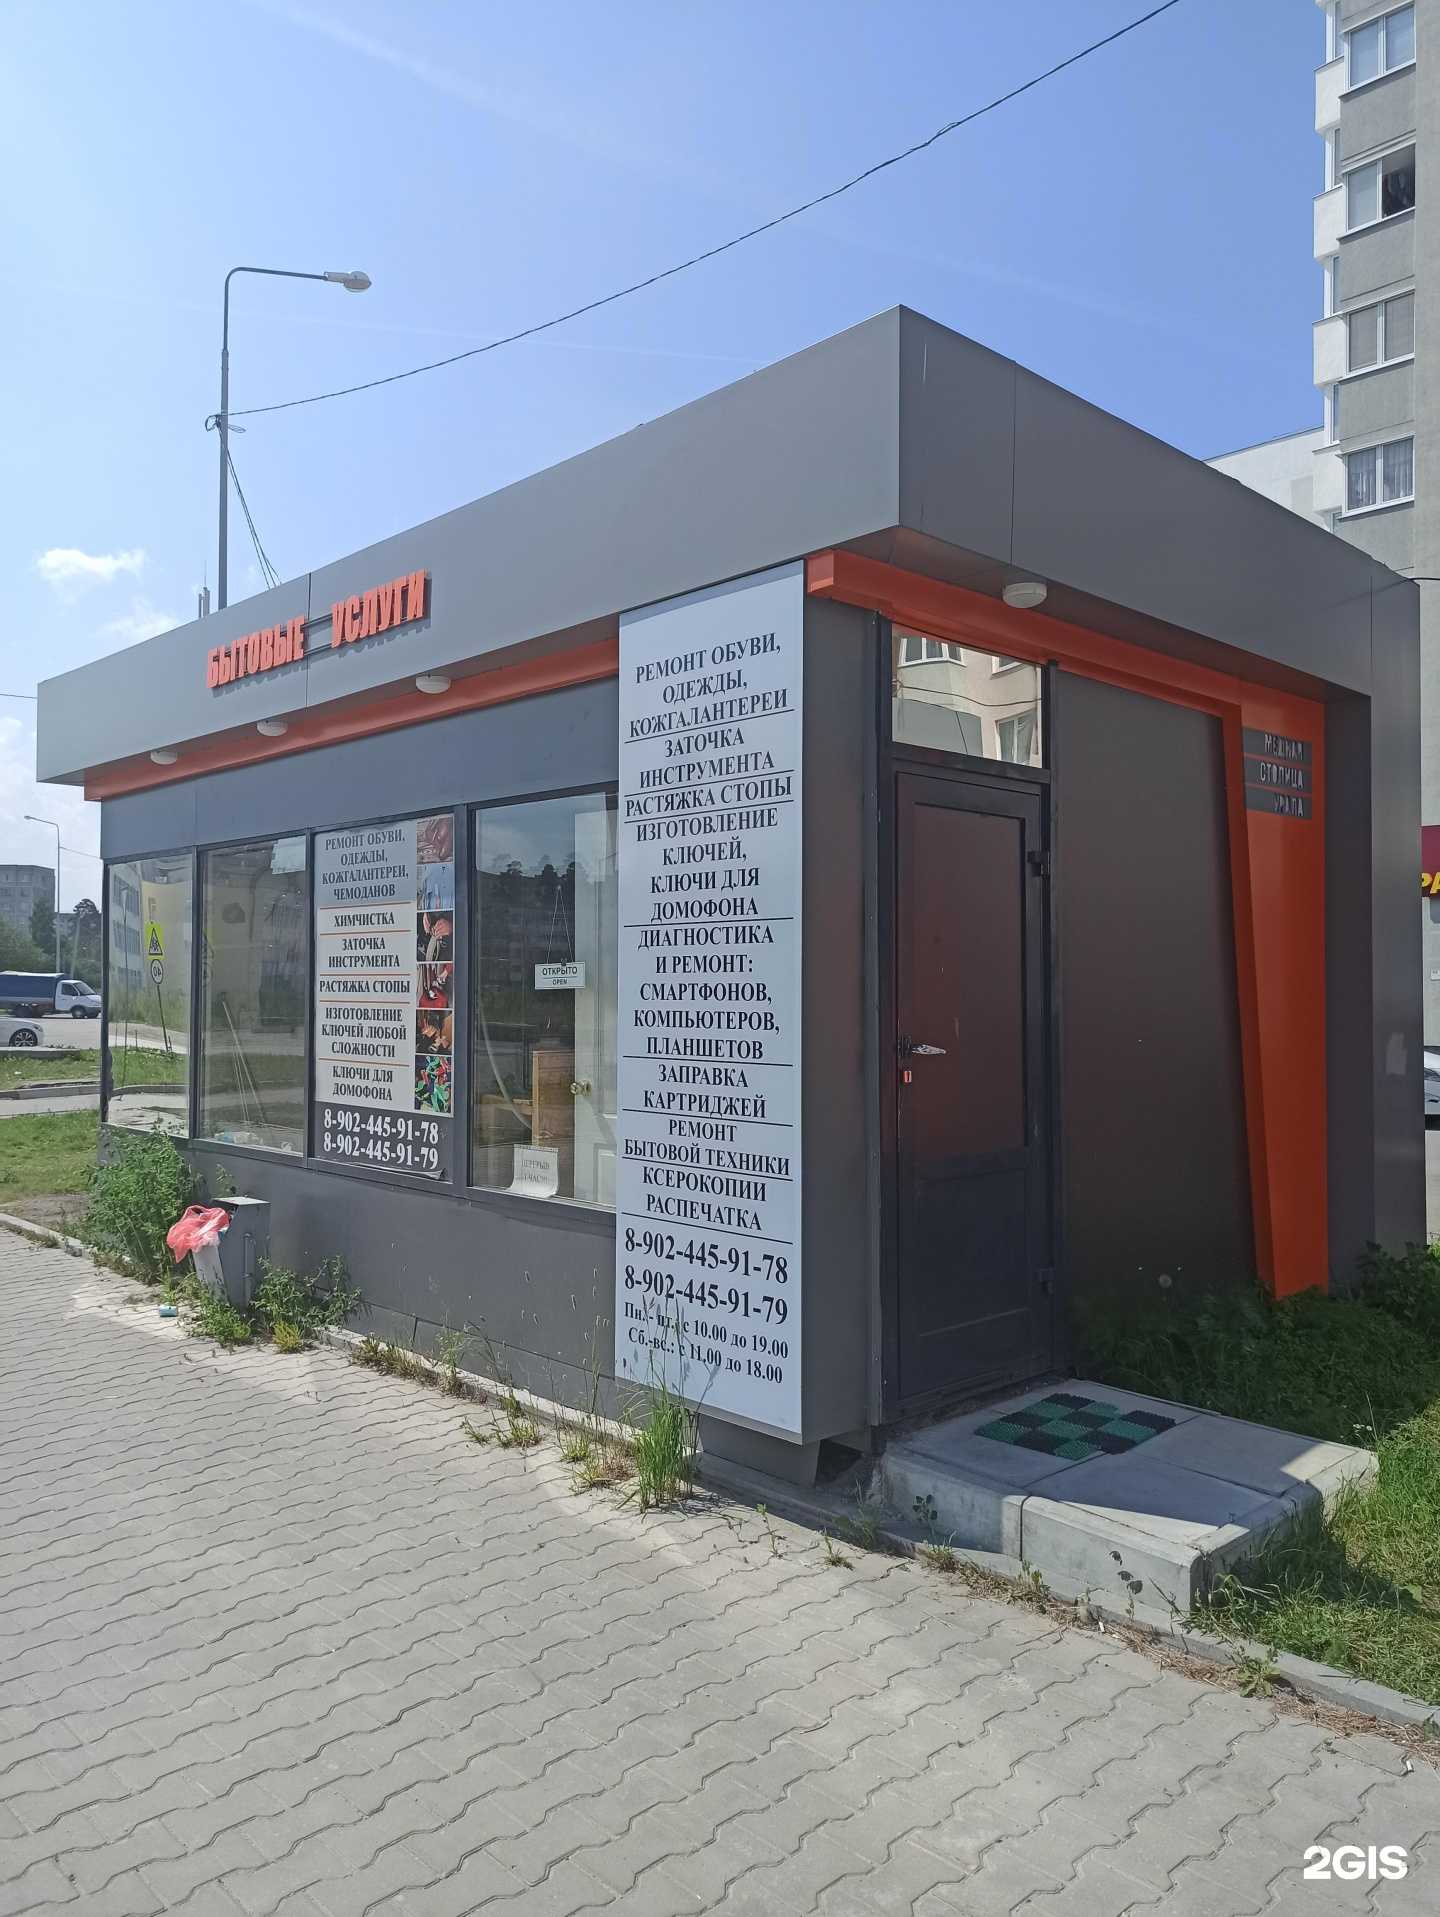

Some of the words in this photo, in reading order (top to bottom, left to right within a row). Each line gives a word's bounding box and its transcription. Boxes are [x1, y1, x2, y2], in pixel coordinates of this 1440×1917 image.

[206, 615, 305, 689] БЫТОВЫЕ
[331, 569, 427, 649] УСЛУГИ
[636, 650, 707, 684] РЕМОНТ
[711, 632, 781, 665] ОБУВИ,
[663, 669, 747, 705] ОДЕЖДЫ,
[630, 689, 787, 738] КОЖГАЛАНТЕРЕИ
[664, 727, 744, 758] ЗАТОЧКА
[640, 751, 775, 788] ИНСТРУМЕНТА
[1260, 762, 1304, 790] СТОЛИЦА
[626, 787, 716, 817] РАСТЯЖКА
[720, 776, 792, 804] СТОПЫ
[1273, 793, 1304, 817] УРАЛА
[637, 808, 778, 841] ИЗГОТОВЛЕНИЕ
[325, 834, 364, 850] РЕМОНТ
[368, 829, 405, 846] ОБУВИ,
[663, 837, 747, 866] КЛЮЧЕЙ,
[340, 850, 388, 866] ОДЕЖДЫ,
[333, 884, 396, 901] ЧЕМОДАНОВ
[650, 872, 716, 894] КЛЮЧИ
[720, 868, 760, 890] ДЛЯ
[334, 911, 395, 927] ХИМЧИСТКА
[650, 897, 758, 923] ДОМОФОНА
[342, 937, 386, 951] ЗАТОЧКА
[638, 925, 774, 950] ДИАГНОСТИКА
[328, 954, 400, 968] ИНСТРУМЕНТА
[542, 966, 578, 976] ОТКРЫТО
[656, 956, 667, 974] И
[672, 954, 753, 974] РЕМОНТ:
[319, 980, 371, 993] РАСТЯЖКА
[373, 980, 410, 993] СТОПЫ
[640, 982, 772, 1004] СМАРТФОНОВ,
[325, 1007, 403, 1022] ИЗГОТОВЛЕНИЕ
[634, 1009, 780, 1035] КОМПЬЮТЕРОВ,
[322, 1023, 364, 1038] КЛЮЧЕЙ
[366, 1024, 407, 1041] ЛЮБОЙ
[331, 1041, 396, 1058] СЛОЖНОСТИ
[647, 1036, 763, 1059] ПЛАНШЕТОВ
[332, 1065, 370, 1081] КЛЮЧИ
[372, 1069, 393, 1083] ДЛЯ
[658, 1064, 749, 1088] ЗАПРАВКА
[332, 1082, 393, 1101] ДОМОФОНА
[643, 1090, 767, 1119] КАРТРИДЖЕЙ
[324, 1108, 439, 1144] 8-902-445-91-78
[668, 1119, 737, 1142] РЕМОНТ
[323, 1131, 439, 1170] 8-902-445-91-79
[624, 1139, 700, 1165] БЫТОВОЙ
[705, 1148, 790, 1177] ТЕХНИКИ
[642, 1166, 767, 1202] КСЕРОКОПИИ
[646, 1193, 762, 1231] РАСПЕЧАТКА
[625, 1227, 788, 1284] 8-902-445-91-78
[624, 1264, 788, 1325] 8-902-445-91-79
[694, 1319, 728, 1343] 10.00
[730, 1333, 747, 1349] до
[752, 1335, 789, 1359] 19.00
[690, 1343, 722, 1367] 11.00
[725, 1358, 741, 1373] до
[747, 1360, 783, 1384] 18.00
